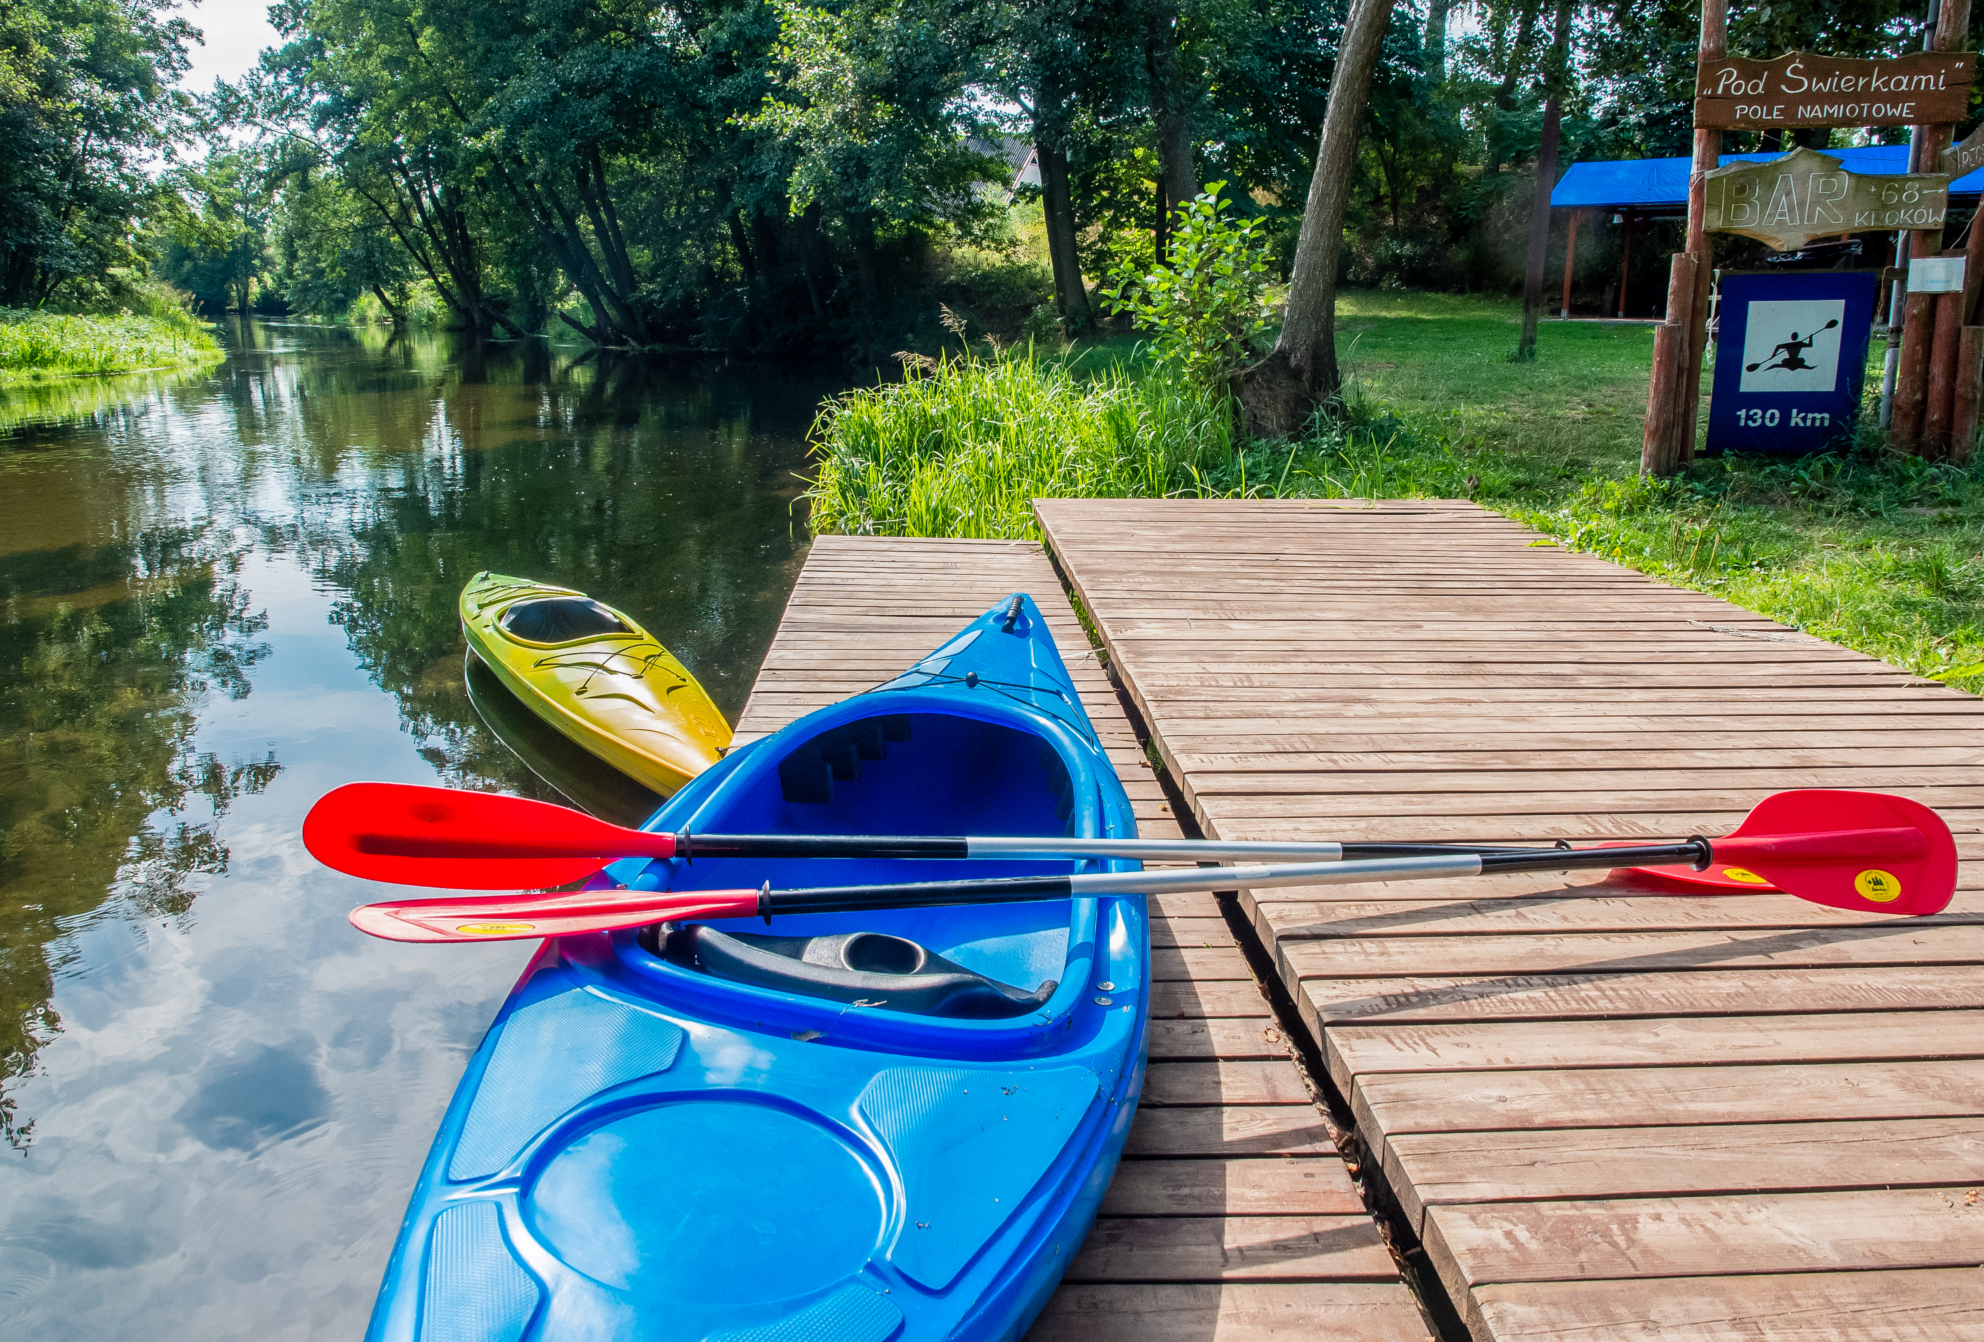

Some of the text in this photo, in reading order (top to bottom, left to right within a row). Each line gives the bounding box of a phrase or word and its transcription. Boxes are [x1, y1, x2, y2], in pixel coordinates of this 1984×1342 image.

[1735, 102, 1916, 119] POLE NAMIOTOWE
[1719, 170, 1849, 228] BAR
[1735, 407, 1830, 427] 130 km
